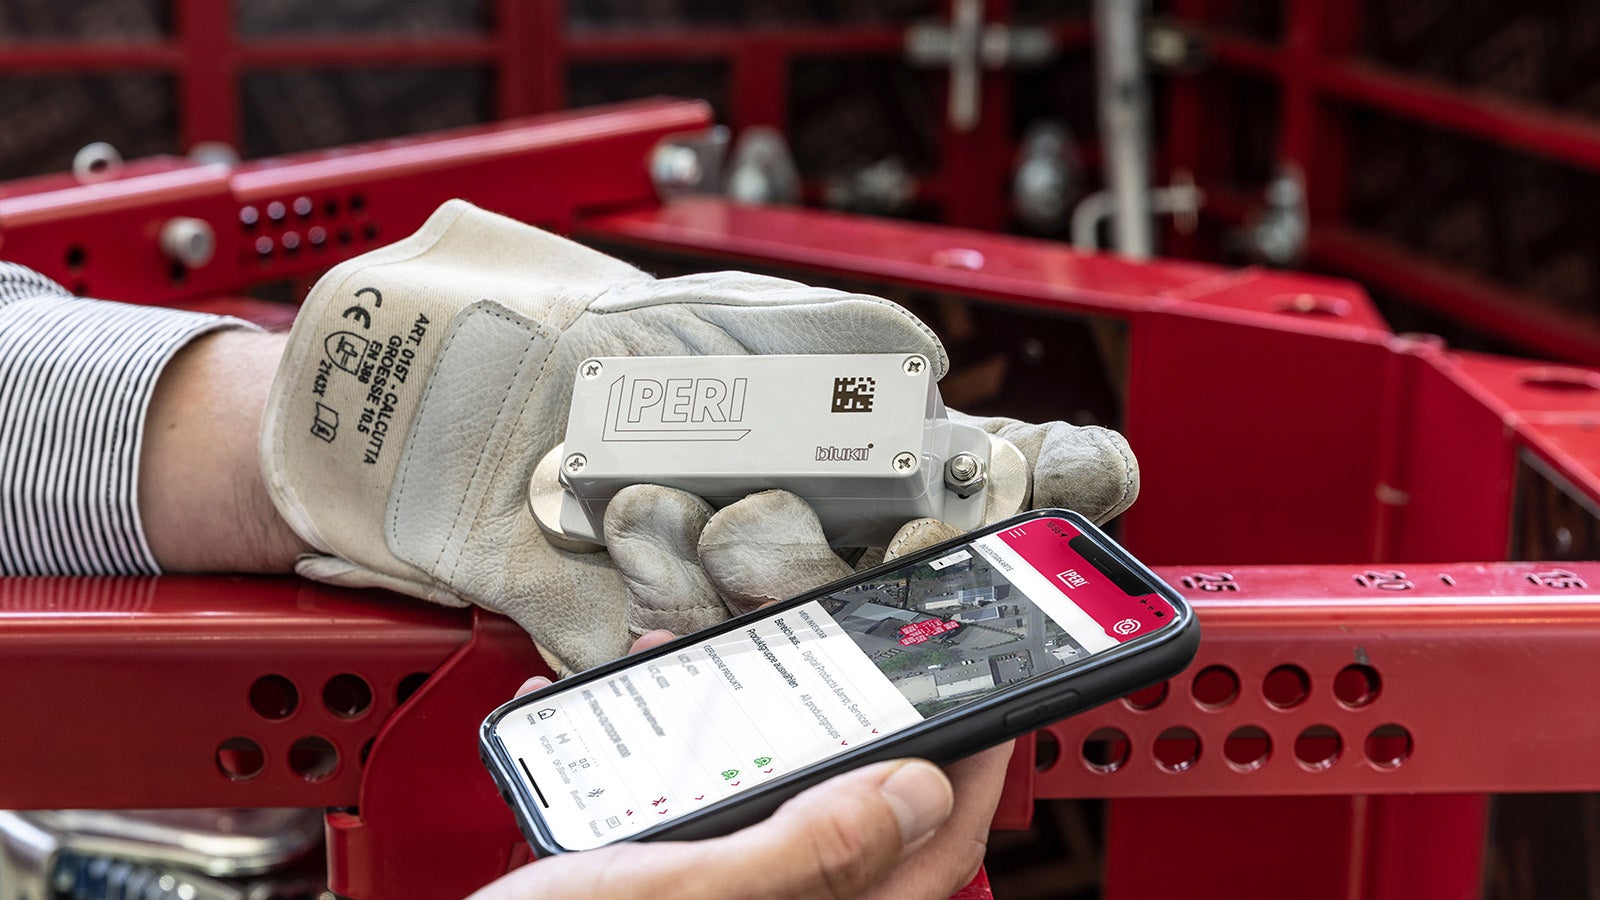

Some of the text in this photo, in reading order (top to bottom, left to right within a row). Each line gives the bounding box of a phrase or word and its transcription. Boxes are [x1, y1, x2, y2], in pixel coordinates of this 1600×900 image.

[405, 313, 430, 346] ART.
[312, 359, 332, 397] 2143X
[357, 340, 383, 385] EN 388
[393, 349, 415, 384] 0157
[357, 335, 402, 435] GROESSE 10.5
[626, 377, 749, 424] PERI
[363, 393, 398, 465] CALCUTTA
[1063, 570, 1088, 587] PERI
[774, 618, 793, 640] Bereich
[746, 628, 798, 688] Produktgruppe auswählen
[720, 667, 743, 691] PRODUKTE
[802, 650, 822, 668] Digital
[816, 665, 838, 689] Products
[847, 704, 871, 728] Services
[803, 699, 840, 739] productgroups
